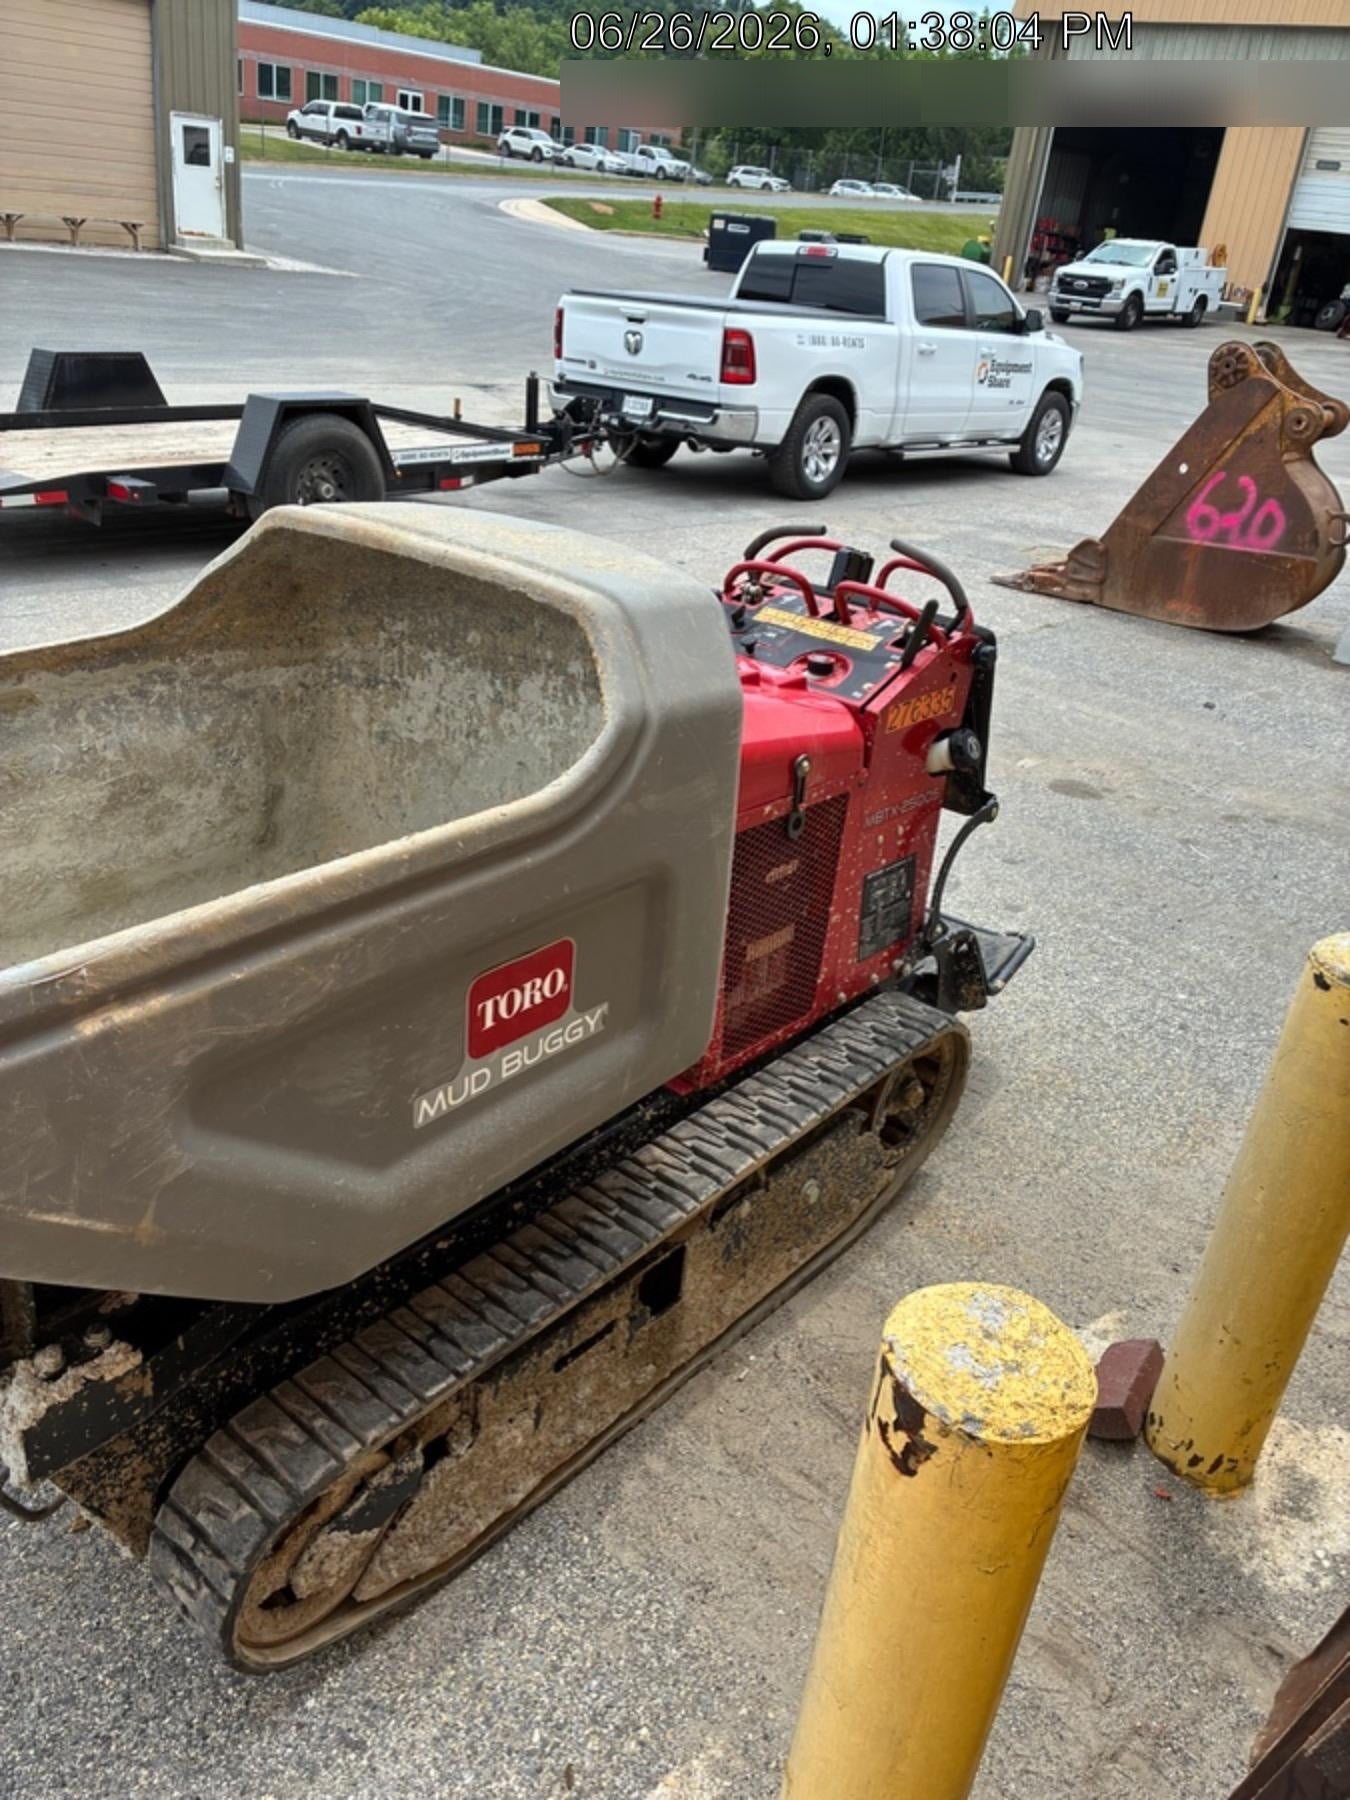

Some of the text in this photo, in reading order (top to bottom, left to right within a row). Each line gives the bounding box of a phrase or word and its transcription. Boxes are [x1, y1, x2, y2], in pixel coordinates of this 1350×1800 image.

[1186, 470, 1286, 552] 620
[477, 967, 566, 1031] TORO
[417, 1007, 604, 1124] MUD BUGGY
